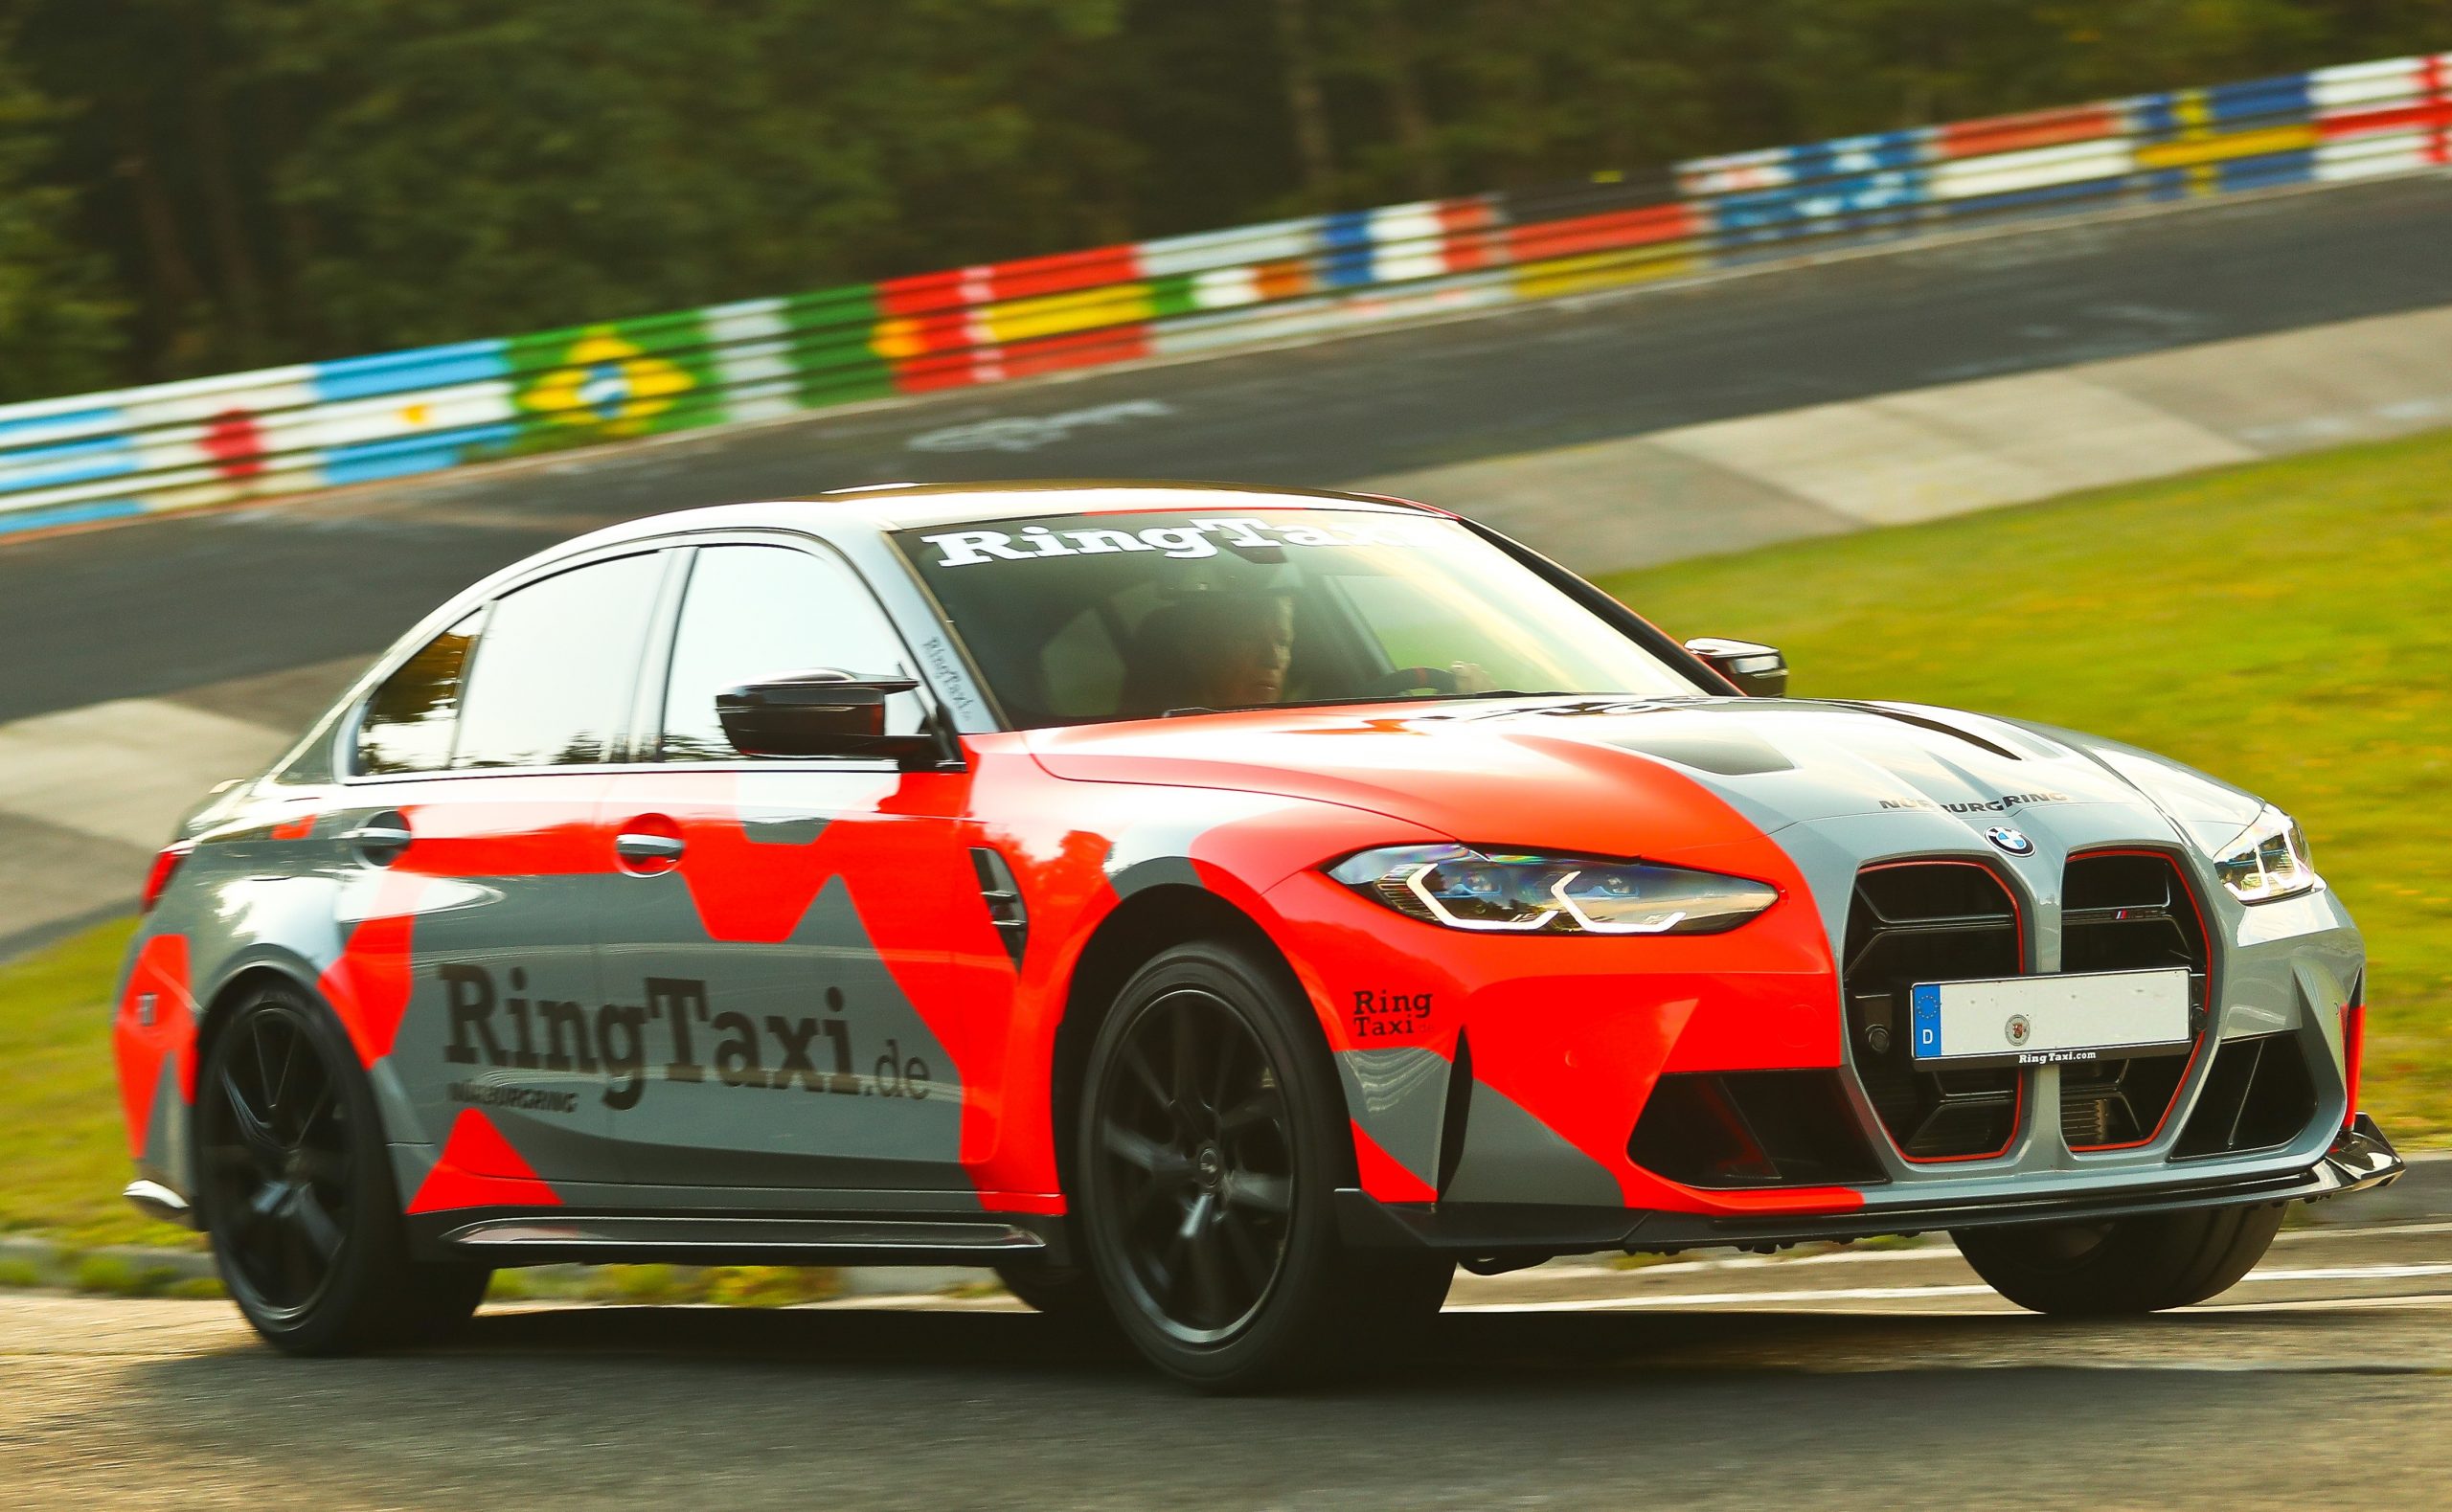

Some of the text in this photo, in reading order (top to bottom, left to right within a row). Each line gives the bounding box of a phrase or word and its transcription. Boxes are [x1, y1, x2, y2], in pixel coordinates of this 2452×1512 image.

[920, 517, 1436, 567] RingTax
[1353, 989, 1433, 1018] Ring
[439, 963, 931, 1110] RingTaxi.de
[1922, 1029, 1934, 1045] D
